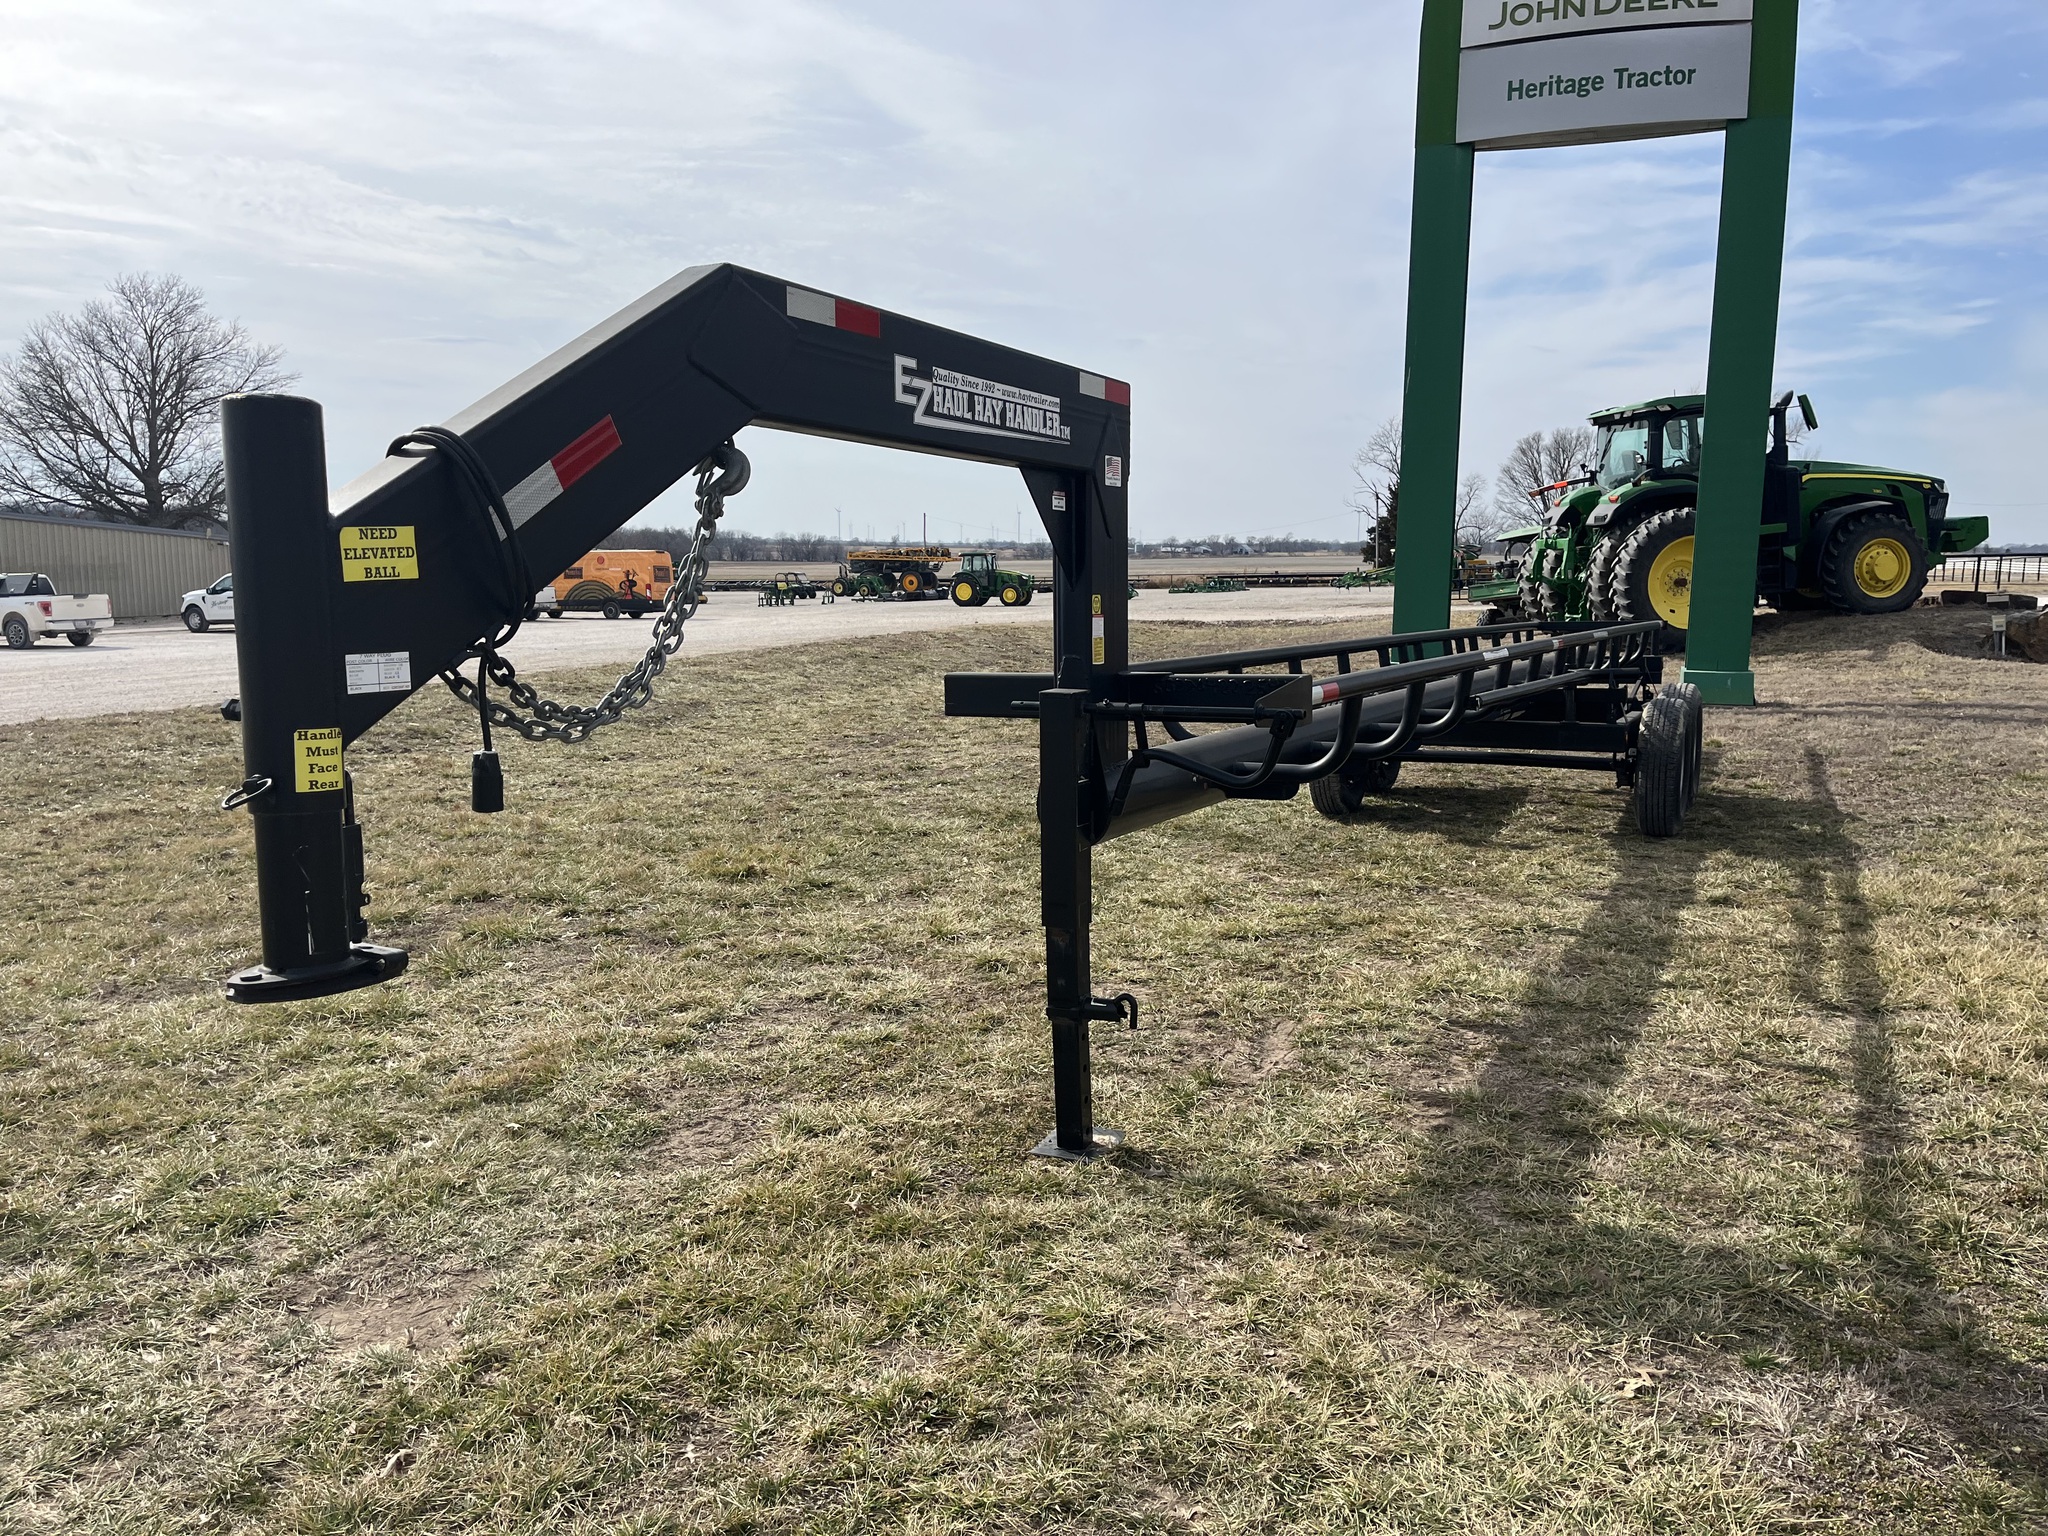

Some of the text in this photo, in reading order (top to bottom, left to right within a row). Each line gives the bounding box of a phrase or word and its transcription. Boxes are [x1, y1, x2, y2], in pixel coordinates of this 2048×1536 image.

[1488, 0, 1586, 30] JOHN
[1507, 65, 1697, 101] Heritage Tractor
[933, 368, 960, 387] Quality
[960, 376, 980, 390] Since
[980, 381, 996, 394] 1992
[1001, 389, 1060, 408] www.haytrailer.com
[933, 386, 972, 420] HAUL
[974, 395, 1004, 426] HAY
[1006, 402, 1060, 438] HANDLER
[358, 528, 397, 540] NEED
[343, 547, 414, 560] ELEVATED
[364, 566, 400, 578] BALL
[297, 729, 342, 740] Handle
[306, 746, 338, 757] Must
[308, 763, 338, 774] Face
[308, 780, 340, 790] Rear
